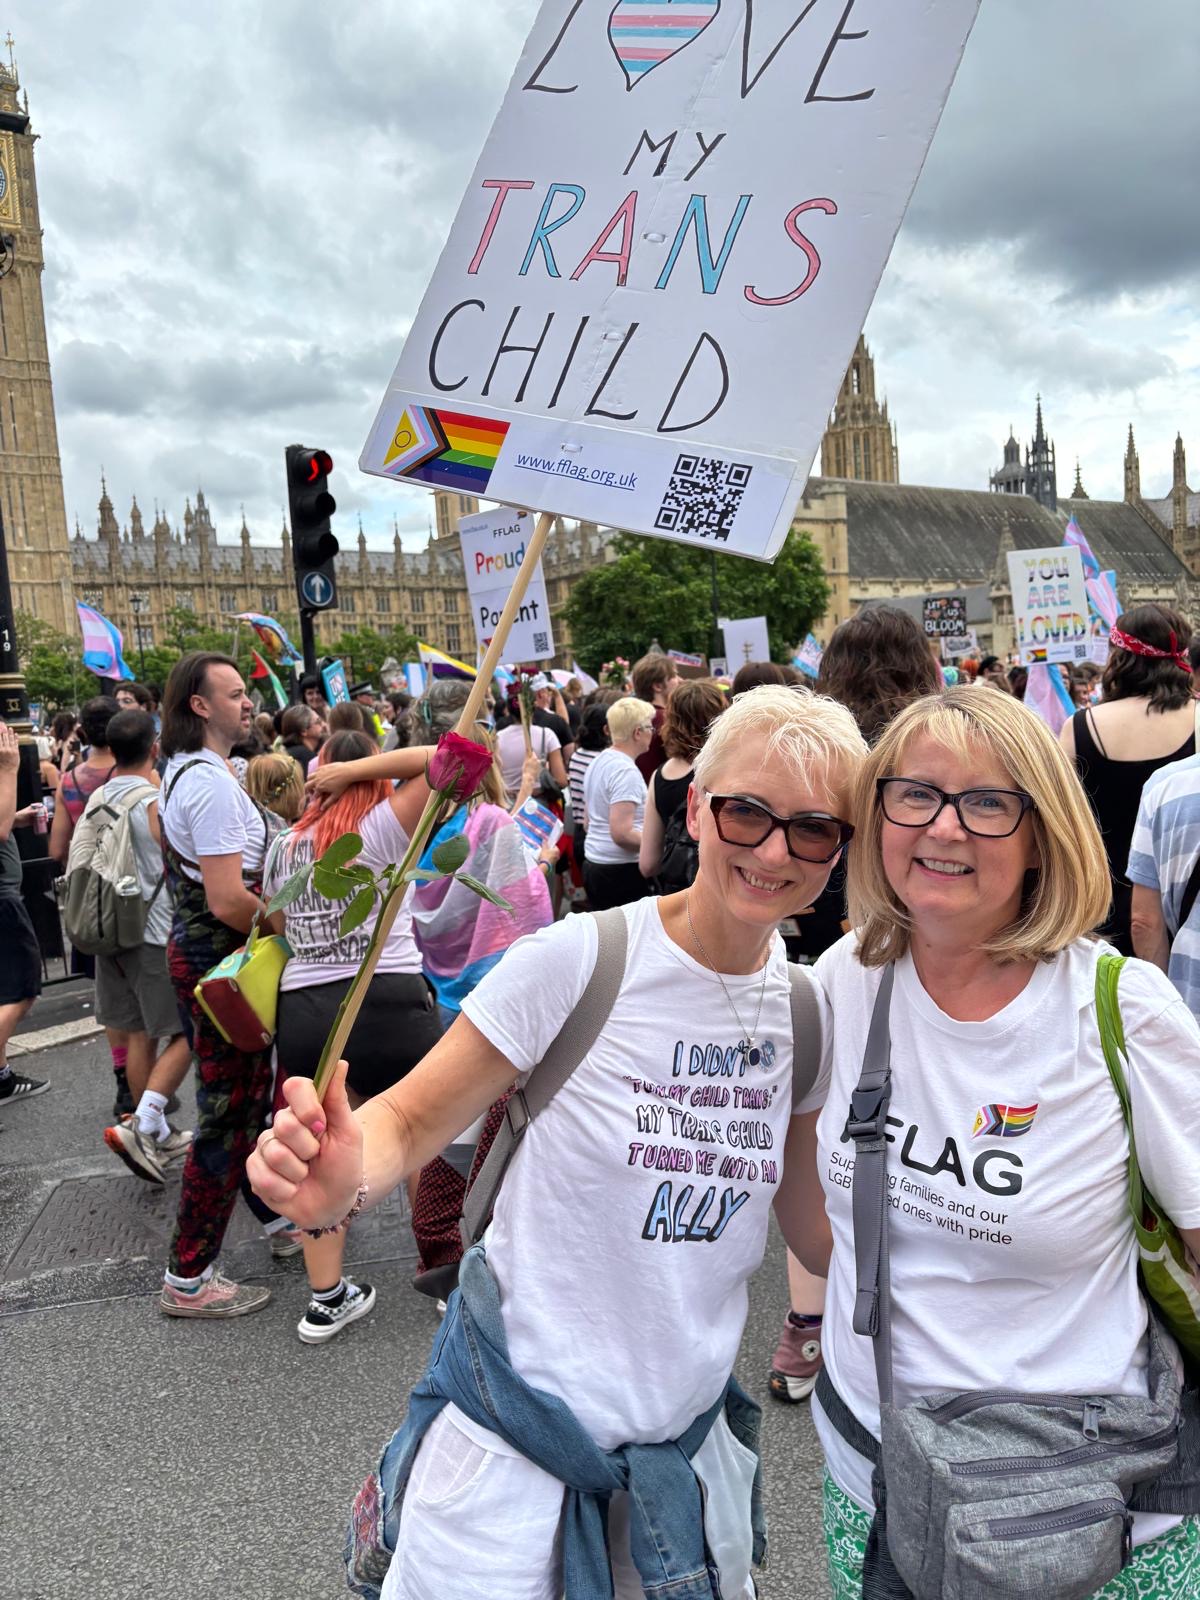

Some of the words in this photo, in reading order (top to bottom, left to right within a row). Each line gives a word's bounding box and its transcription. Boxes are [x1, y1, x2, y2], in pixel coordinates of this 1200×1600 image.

[623, 130, 726, 181] MY
[467, 179, 838, 306] TRANS
[428, 299, 730, 432] CHILD
[515, 454, 638, 490] www.fflag.org.uk
[493, 523, 521, 538] FFLAG
[475, 541, 526, 575] Proud
[1024, 556, 1070, 582] YOU
[480, 600, 539, 628] Pant
[1027, 584, 1071, 609] ARE
[925, 619, 964, 632] BLOOM
[1019, 612, 1086, 646] LOVED
[671, 1040, 684, 1077] I
[668, 1084, 690, 1106] MY
[690, 1084, 730, 1108] CHILD
[637, 1105, 664, 1134] MY
[668, 1107, 724, 1144] TRANS
[727, 1120, 773, 1150] CHILD
[628, 1142, 693, 1173] TURNED
[696, 1150, 717, 1176] ME
[718, 1155, 758, 1182] INTO
[761, 1159, 777, 1184] AN
[641, 1180, 750, 1243] ALLY
[899, 1177, 944, 1207] families
[948, 1199, 975, 1219] and
[979, 1210, 1008, 1225] our
[902, 1202, 932, 1222] ones
[935, 1214, 964, 1236] with
[969, 1226, 1012, 1247] pride
